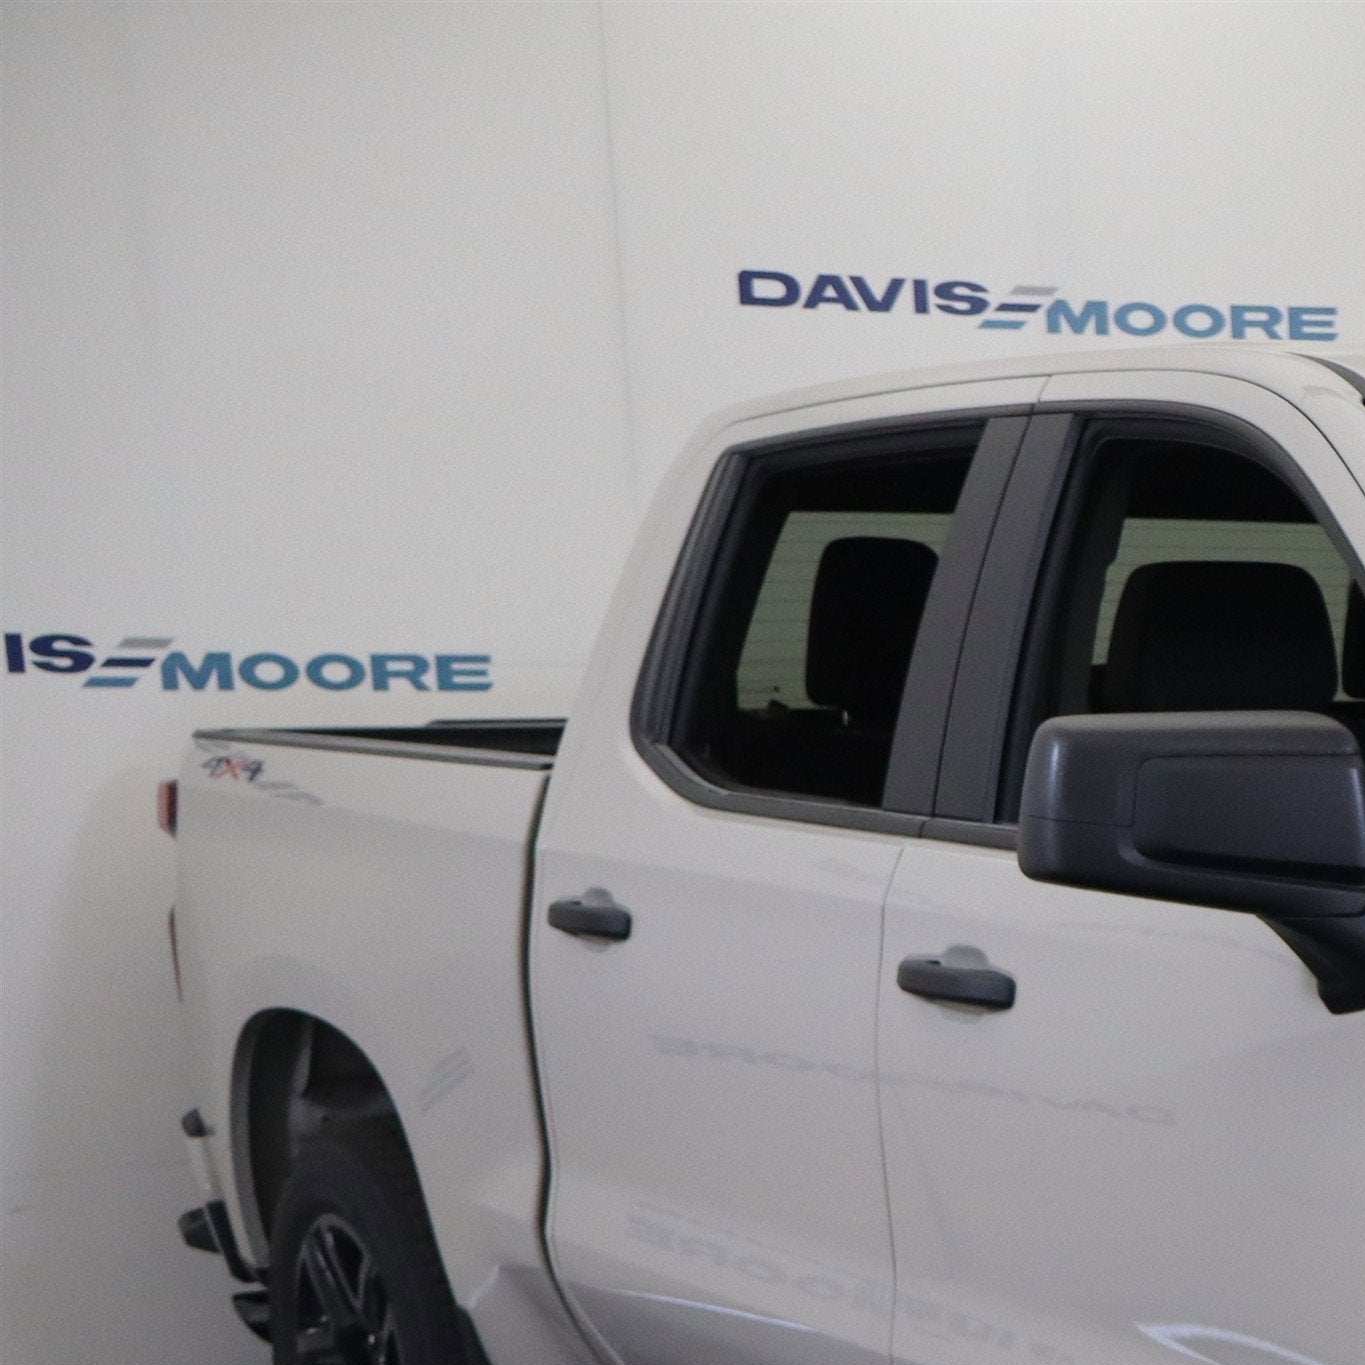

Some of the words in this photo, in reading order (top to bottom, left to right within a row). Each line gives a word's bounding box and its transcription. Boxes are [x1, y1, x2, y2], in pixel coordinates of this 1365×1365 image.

[737, 269, 990, 316] DAVIS
[1046, 299, 1339, 342] MOORE
[160, 651, 493, 692] MOORE
